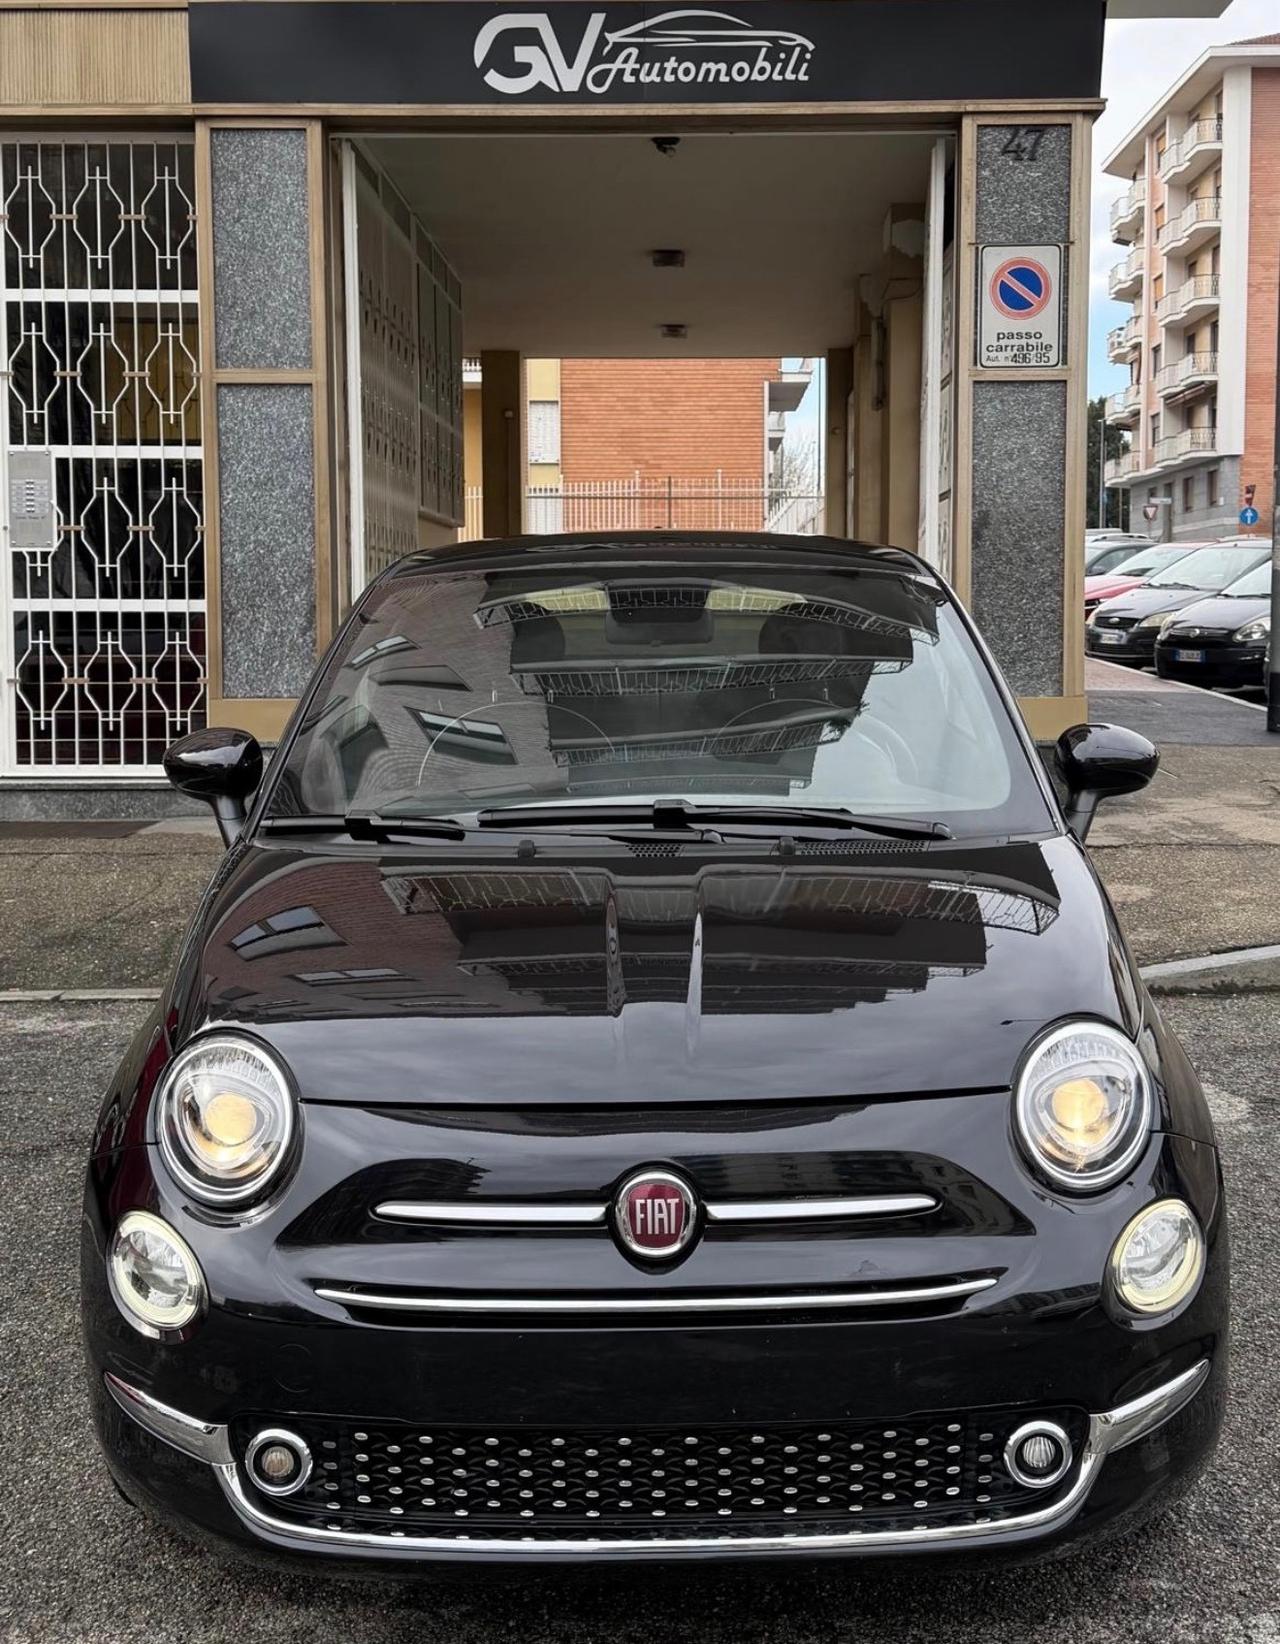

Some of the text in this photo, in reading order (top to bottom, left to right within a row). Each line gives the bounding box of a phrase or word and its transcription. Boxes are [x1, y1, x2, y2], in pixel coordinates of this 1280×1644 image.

[474, 13, 812, 94] GV Automobili
[1001, 126, 1044, 161] 47
[986, 342, 1053, 353] carrabile
[997, 331, 1043, 342] passo
[635, 1198, 680, 1235] FIAT
